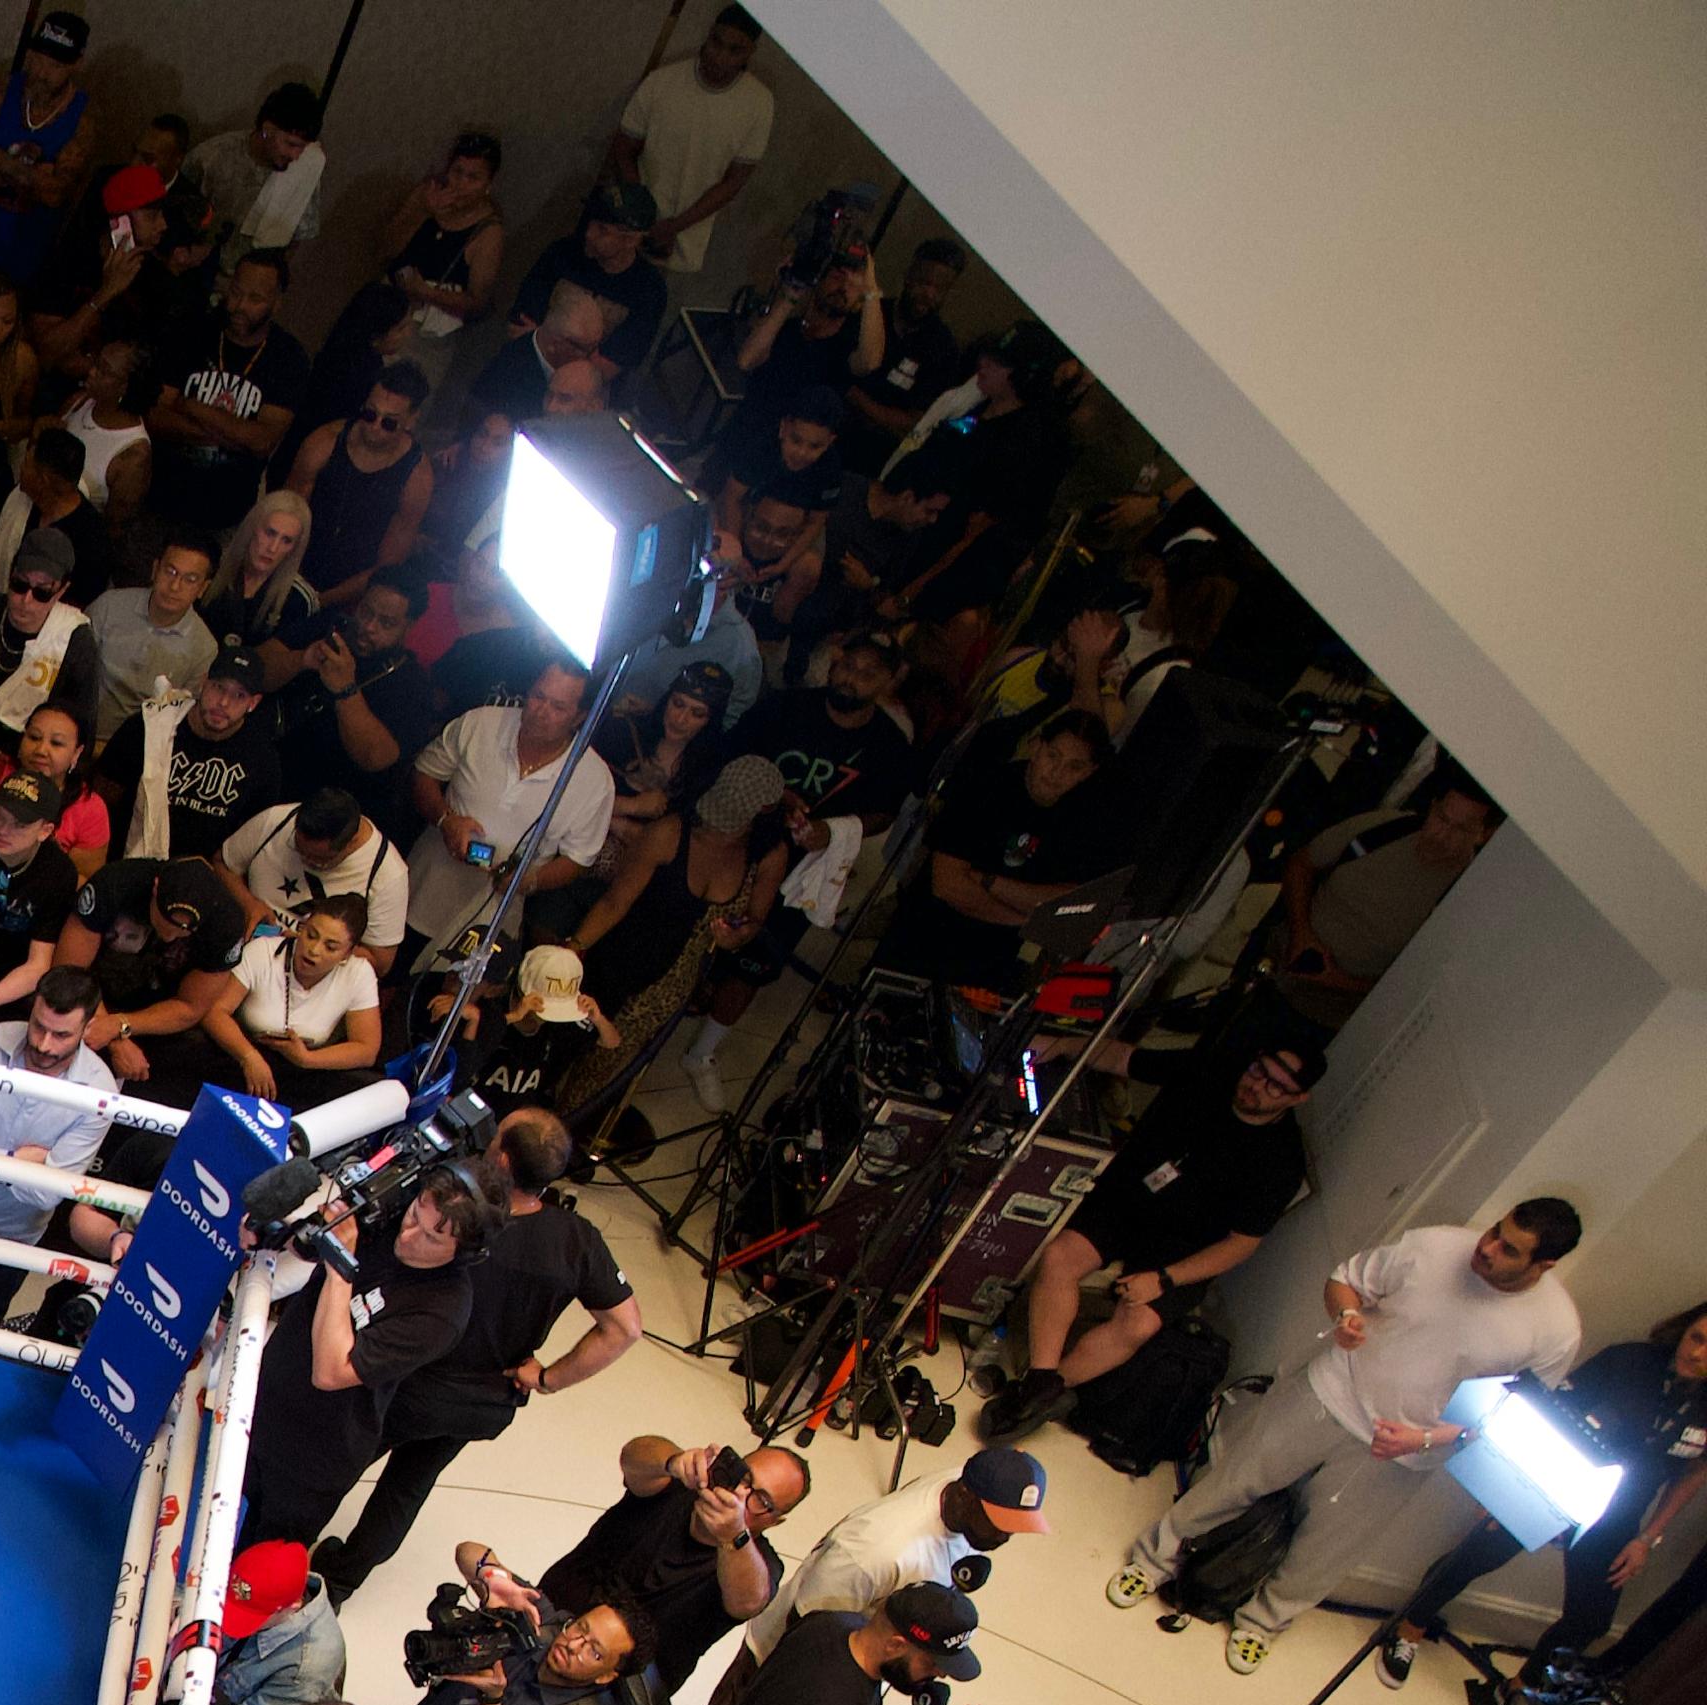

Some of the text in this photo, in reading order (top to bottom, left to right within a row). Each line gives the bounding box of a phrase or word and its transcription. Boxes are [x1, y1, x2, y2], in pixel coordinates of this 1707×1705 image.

[189, 799, 230, 818] BLACK
[221, 1094, 278, 1150] DOORDASH
[160, 1177, 237, 1264] DOORDASH
[113, 1279, 188, 1363] DOORDASH
[70, 1374, 142, 1455] DOORDASH
